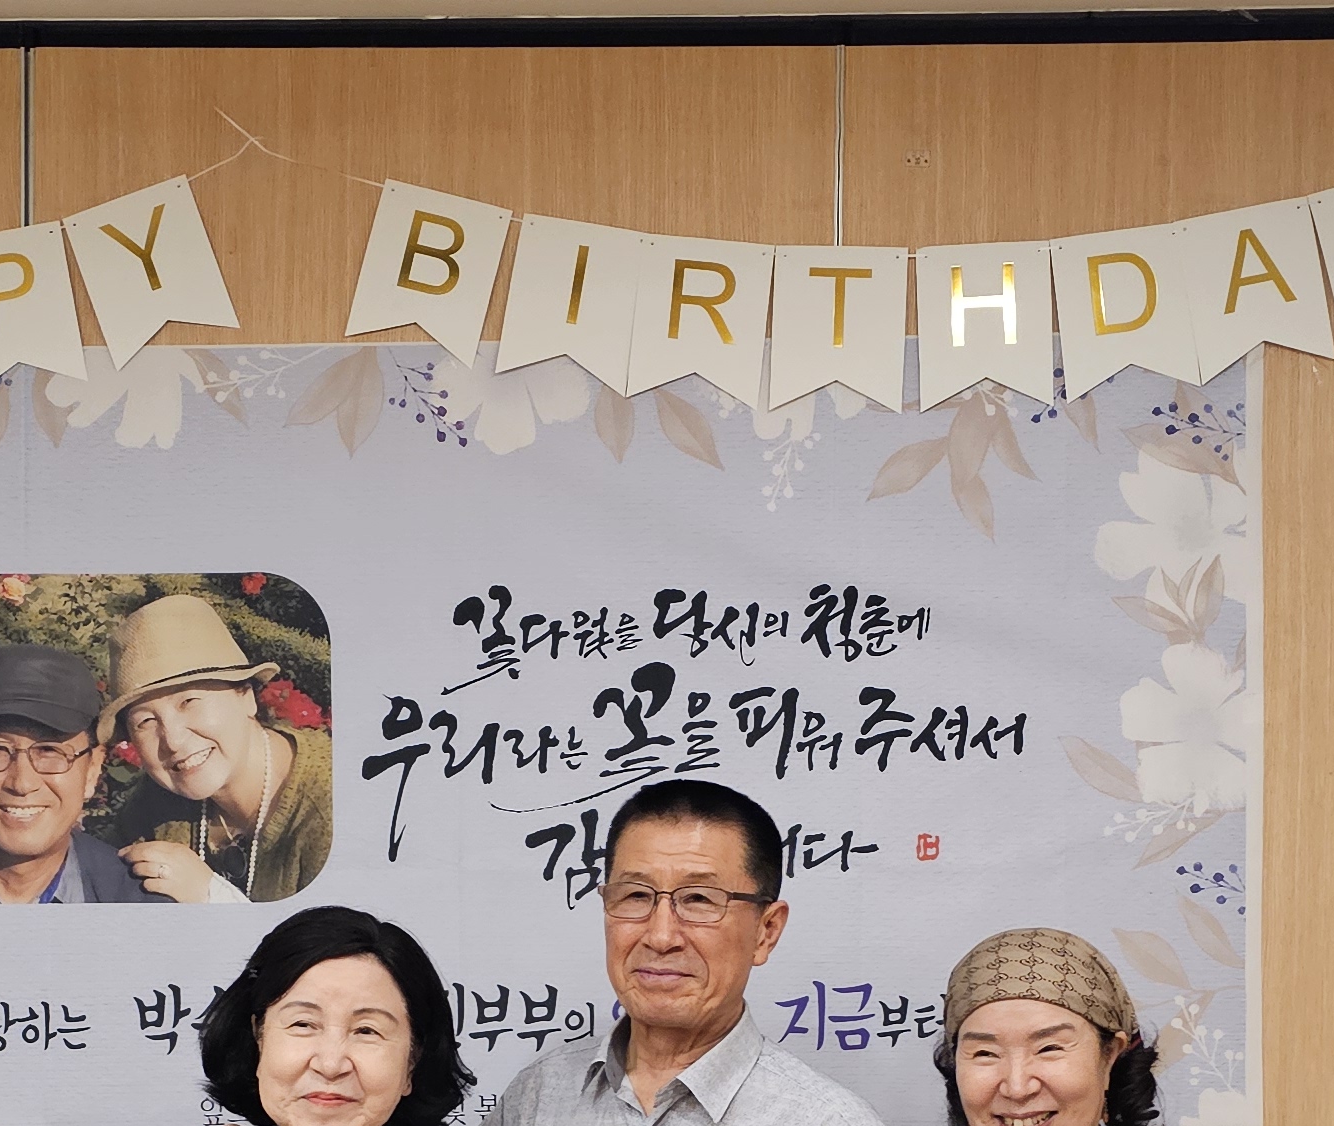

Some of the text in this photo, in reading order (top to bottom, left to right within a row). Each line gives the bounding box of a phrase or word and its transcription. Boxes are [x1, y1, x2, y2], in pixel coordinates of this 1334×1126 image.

[653, 588, 789, 666] 당신의
[801, 583, 931, 662] 청춘에
[361, 692, 590, 863] 우리라는
[728, 686, 842, 779] 피워
[855, 687, 1028, 771] 주셔서
